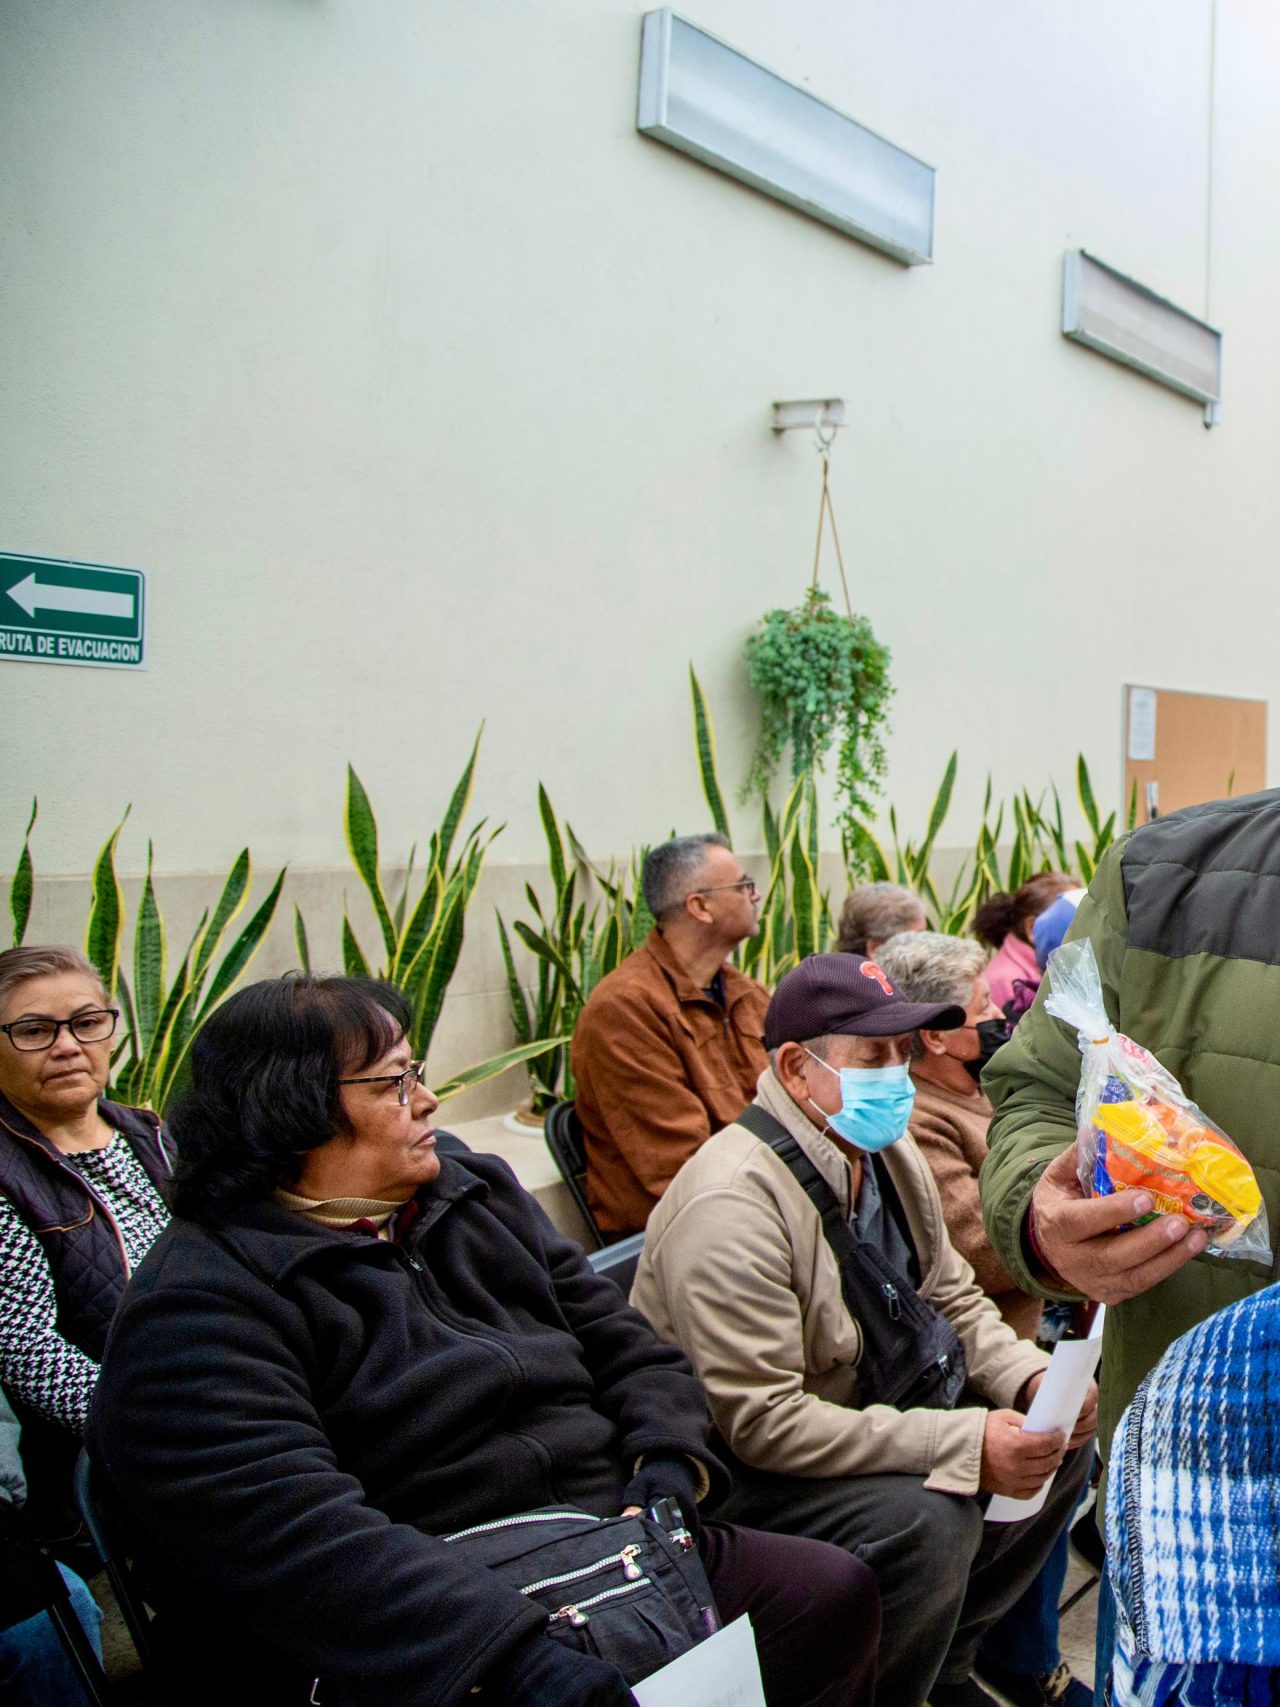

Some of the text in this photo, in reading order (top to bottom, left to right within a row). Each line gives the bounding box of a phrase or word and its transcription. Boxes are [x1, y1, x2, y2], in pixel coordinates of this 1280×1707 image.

[0, 632, 140, 662] RUTA DE EVACUACION
